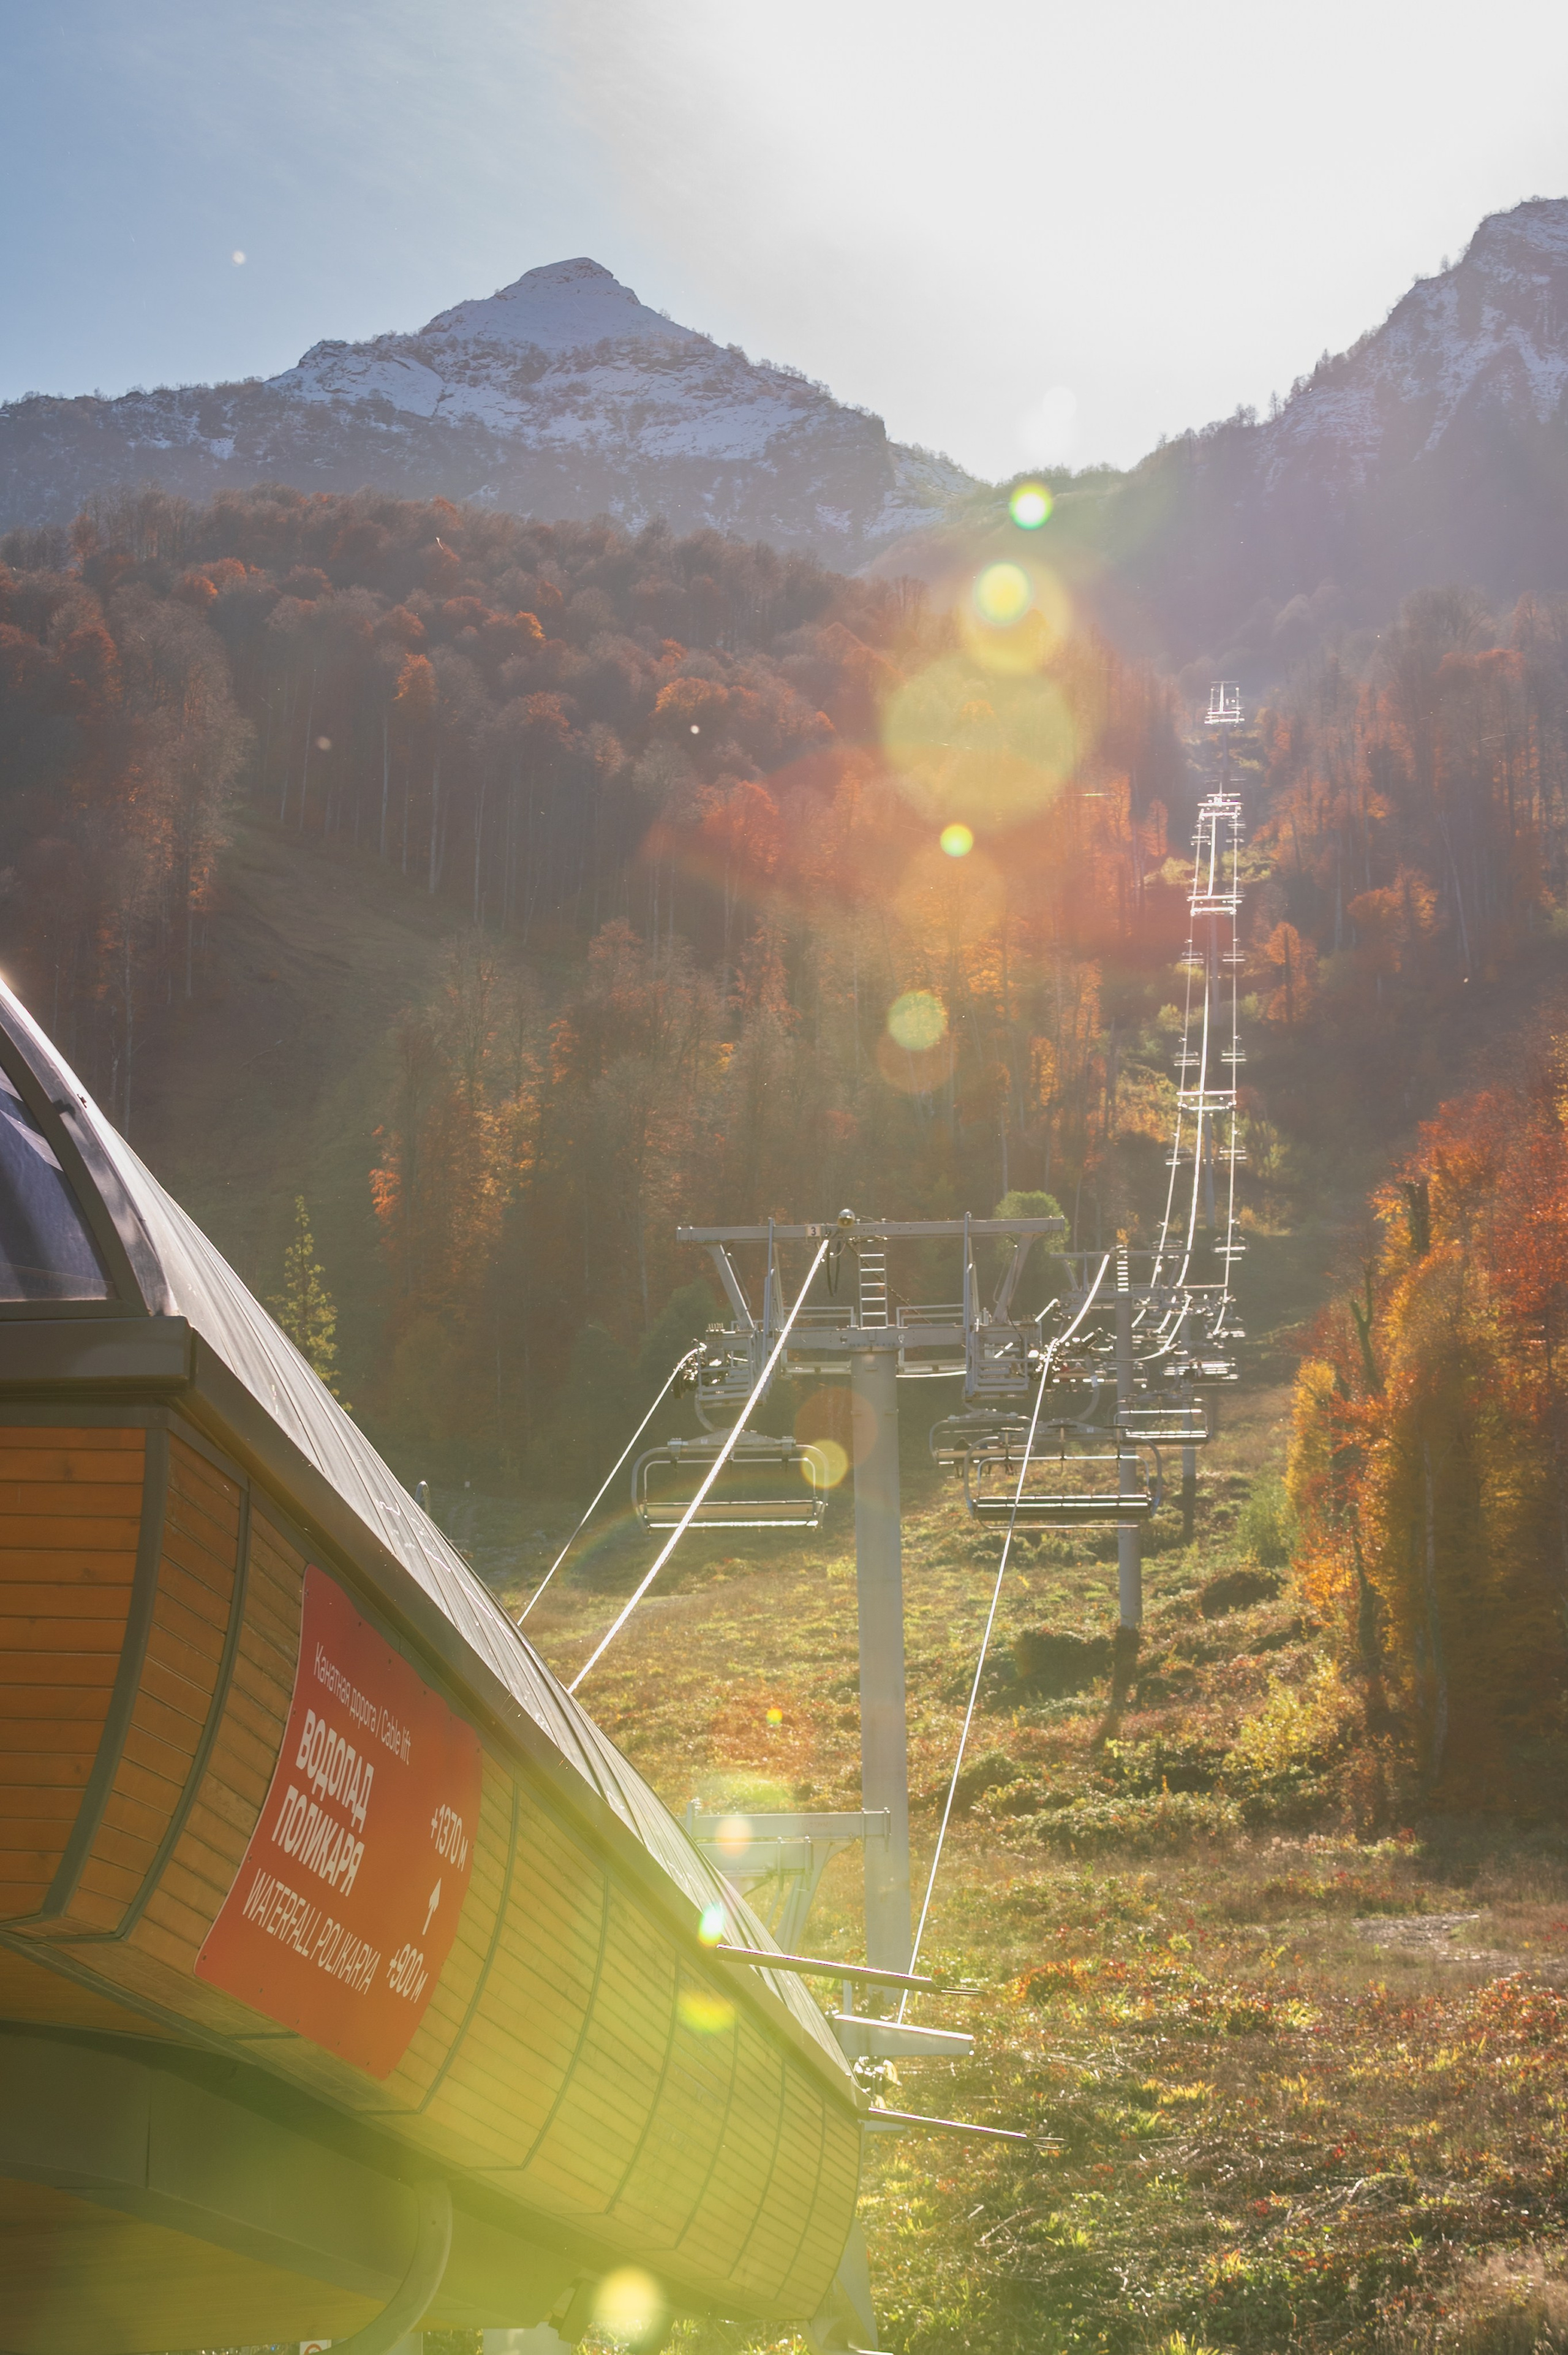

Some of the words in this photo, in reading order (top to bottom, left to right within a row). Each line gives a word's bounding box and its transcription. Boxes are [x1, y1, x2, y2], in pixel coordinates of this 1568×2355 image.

[810, 1227, 816, 1236] 3
[313, 1641, 351, 1708] Канатная
[349, 1687, 377, 1729] дорога
[381, 1709, 402, 1756] Cable
[400, 1726, 411, 1766] lift
[295, 1708, 375, 1834] ВОДОПАД
[271, 1784, 366, 1897] ПОЛИКАРЯ
[243, 1868, 322, 1957] WATERFALL
[309, 1917, 382, 1995] POLIKARYA
